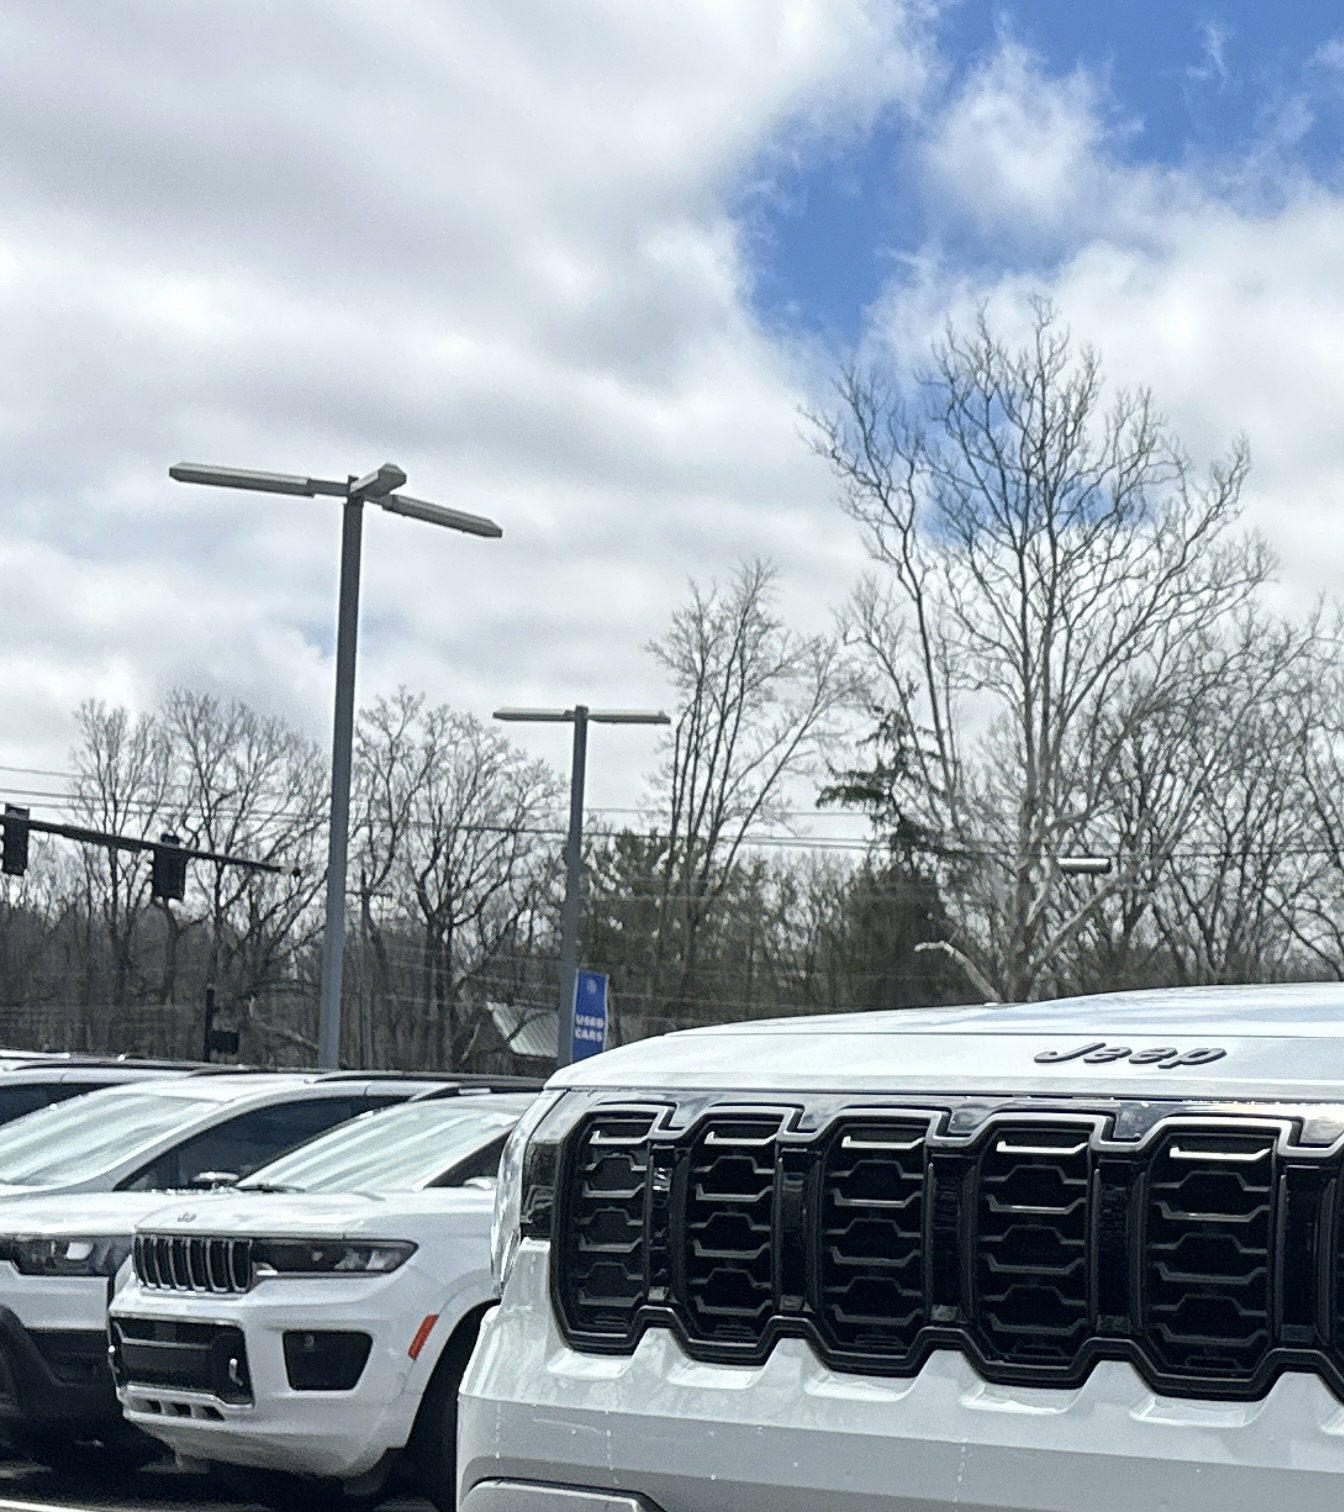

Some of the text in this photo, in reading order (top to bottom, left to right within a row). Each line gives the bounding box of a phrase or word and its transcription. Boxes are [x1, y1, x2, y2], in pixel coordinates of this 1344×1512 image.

[575, 1014, 604, 1028] USED
[575, 1027, 603, 1042] CARS
[1034, 1042, 1227, 1069] Jeep
